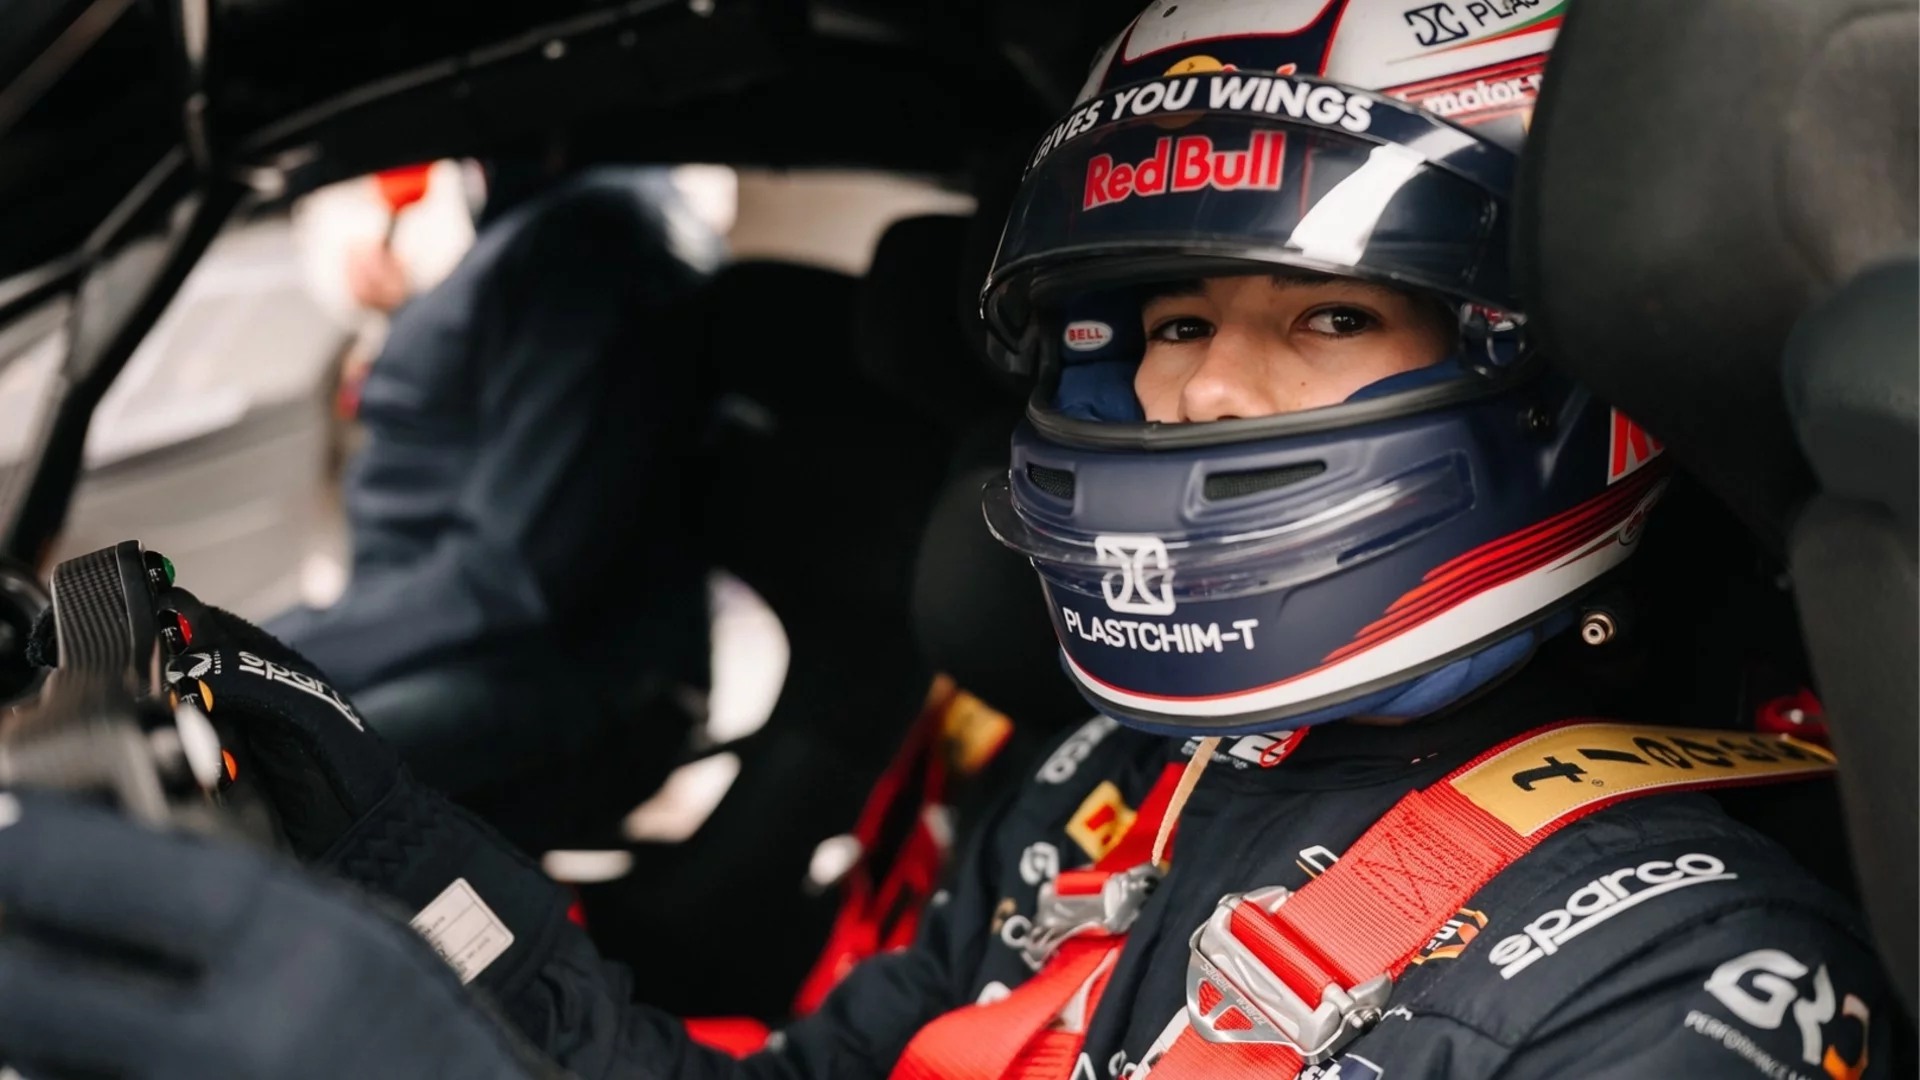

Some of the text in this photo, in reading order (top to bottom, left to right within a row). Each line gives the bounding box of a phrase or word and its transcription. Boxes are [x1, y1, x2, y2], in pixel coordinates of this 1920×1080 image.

[1032, 76, 1374, 168] GIVES YOU WINGS
[1083, 130, 1287, 213] Red Bull
[1067, 327, 1104, 342] BELL
[1062, 606, 1259, 654] PLASTCHIM-T
[1488, 853, 1726, 967] sparco
